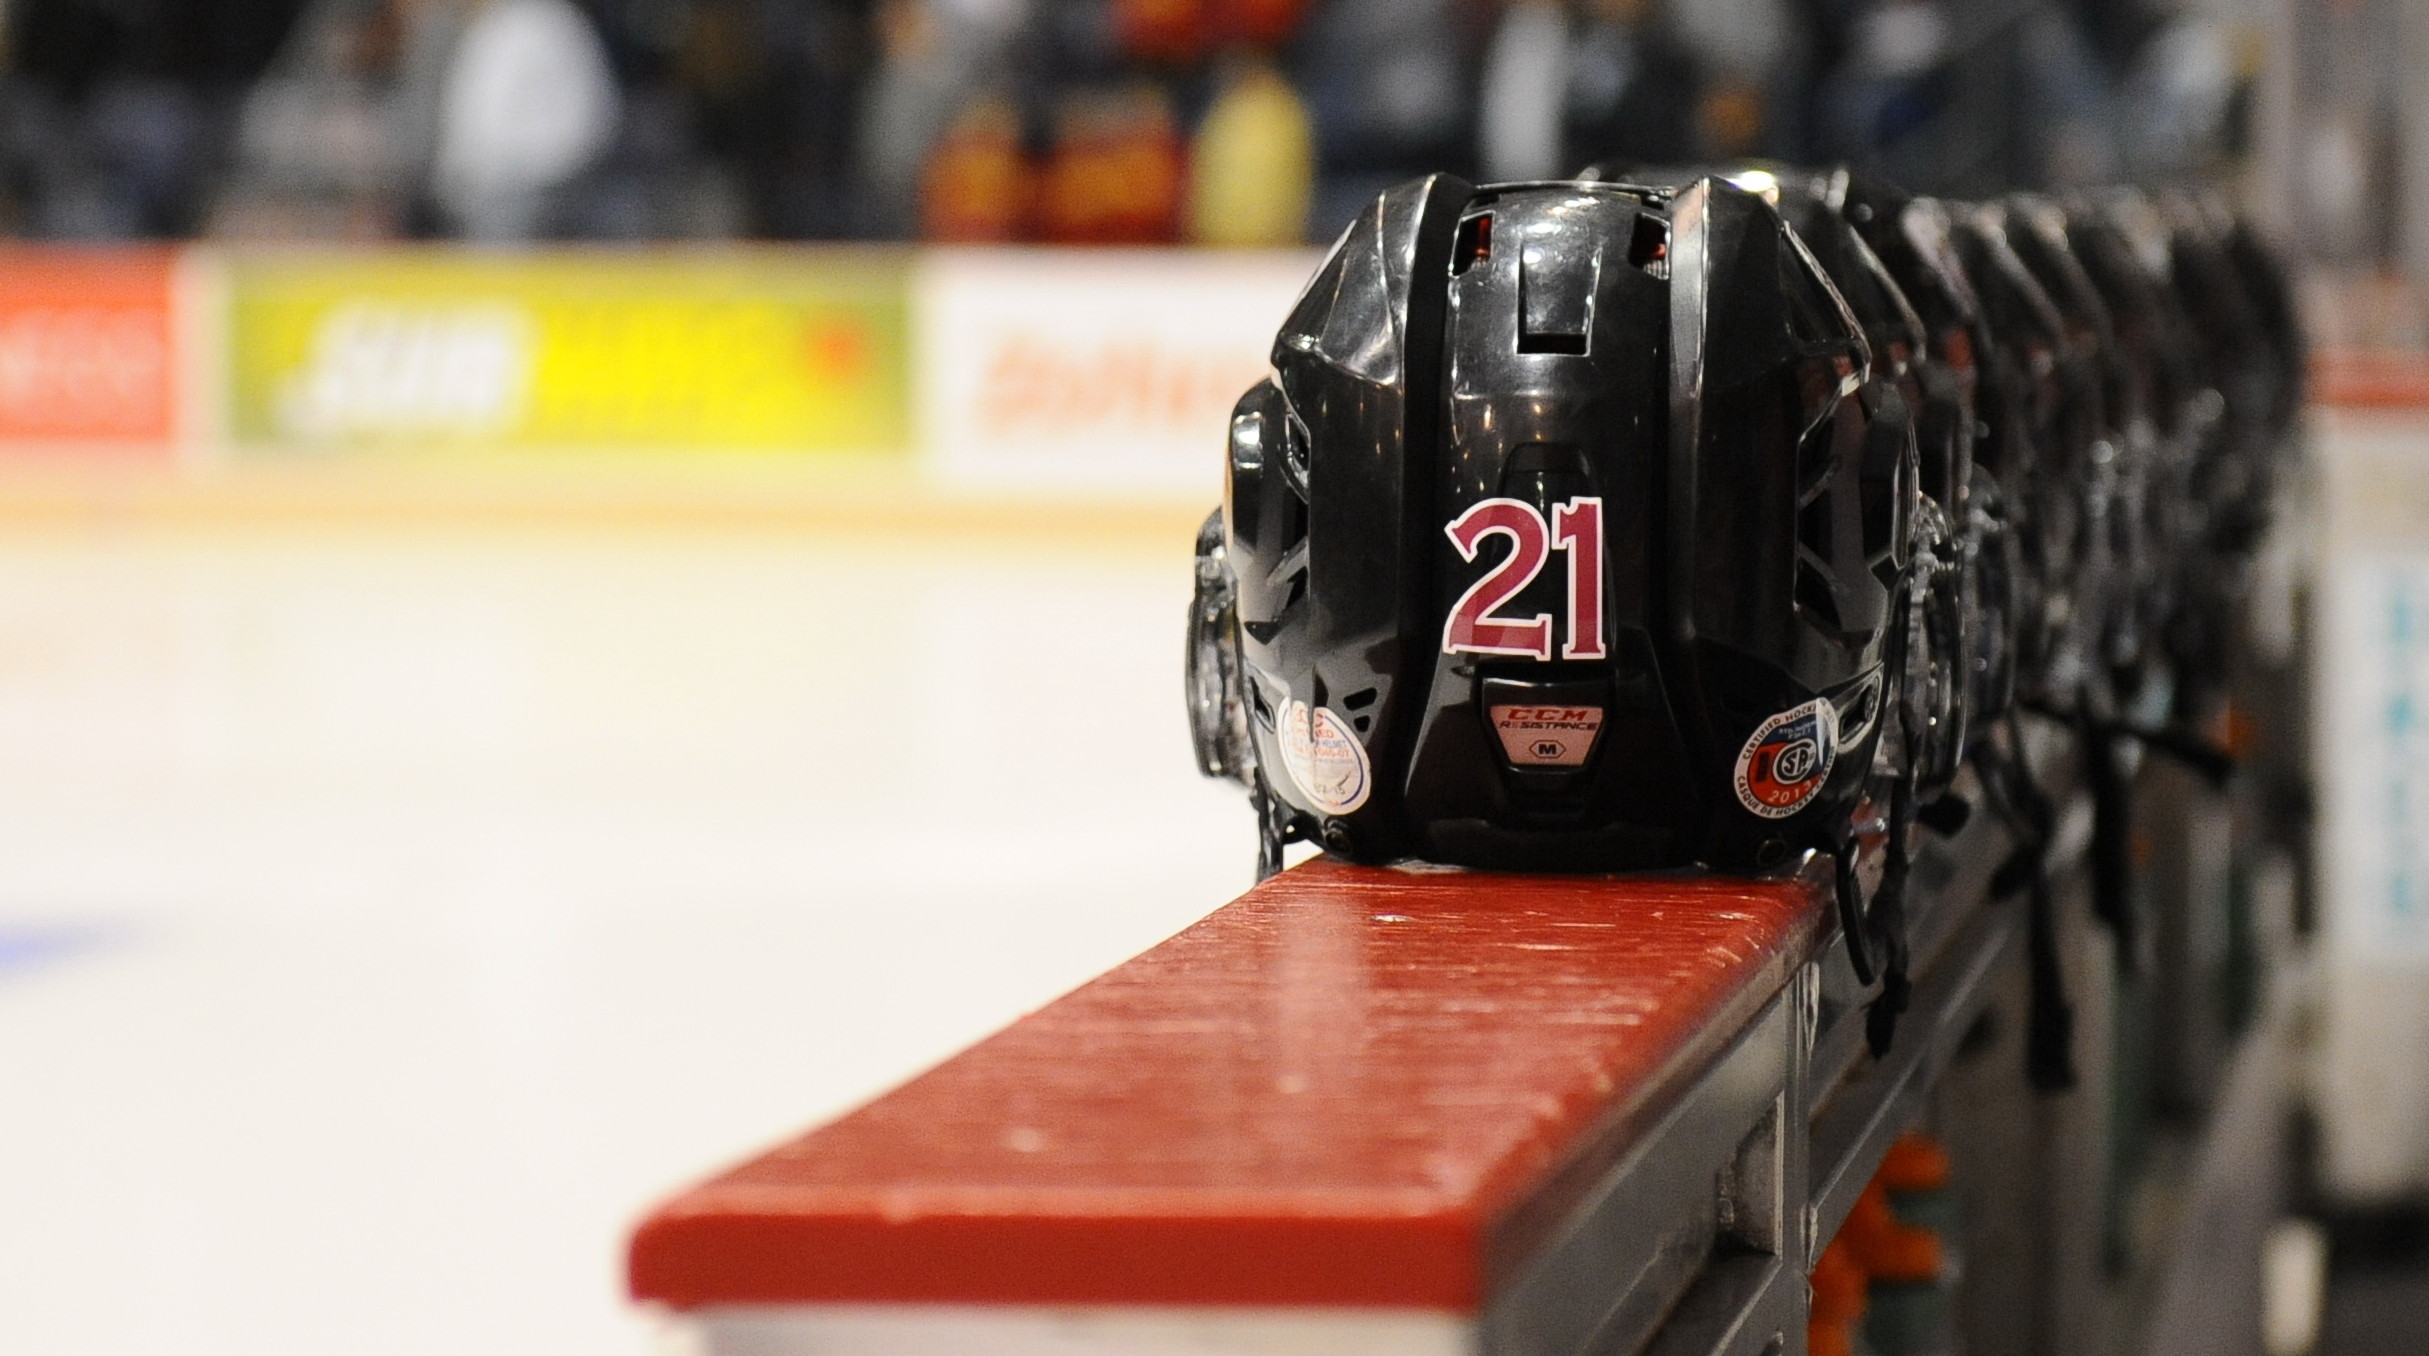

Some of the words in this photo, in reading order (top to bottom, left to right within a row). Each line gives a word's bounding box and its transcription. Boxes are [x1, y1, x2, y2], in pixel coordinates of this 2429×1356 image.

[1443, 496, 1605, 661] 21
[1507, 708, 1588, 721] CCM
[1500, 720, 1599, 731] RESISTANCE
[1538, 743, 1557, 756] M
[1760, 803, 1773, 816] DE
